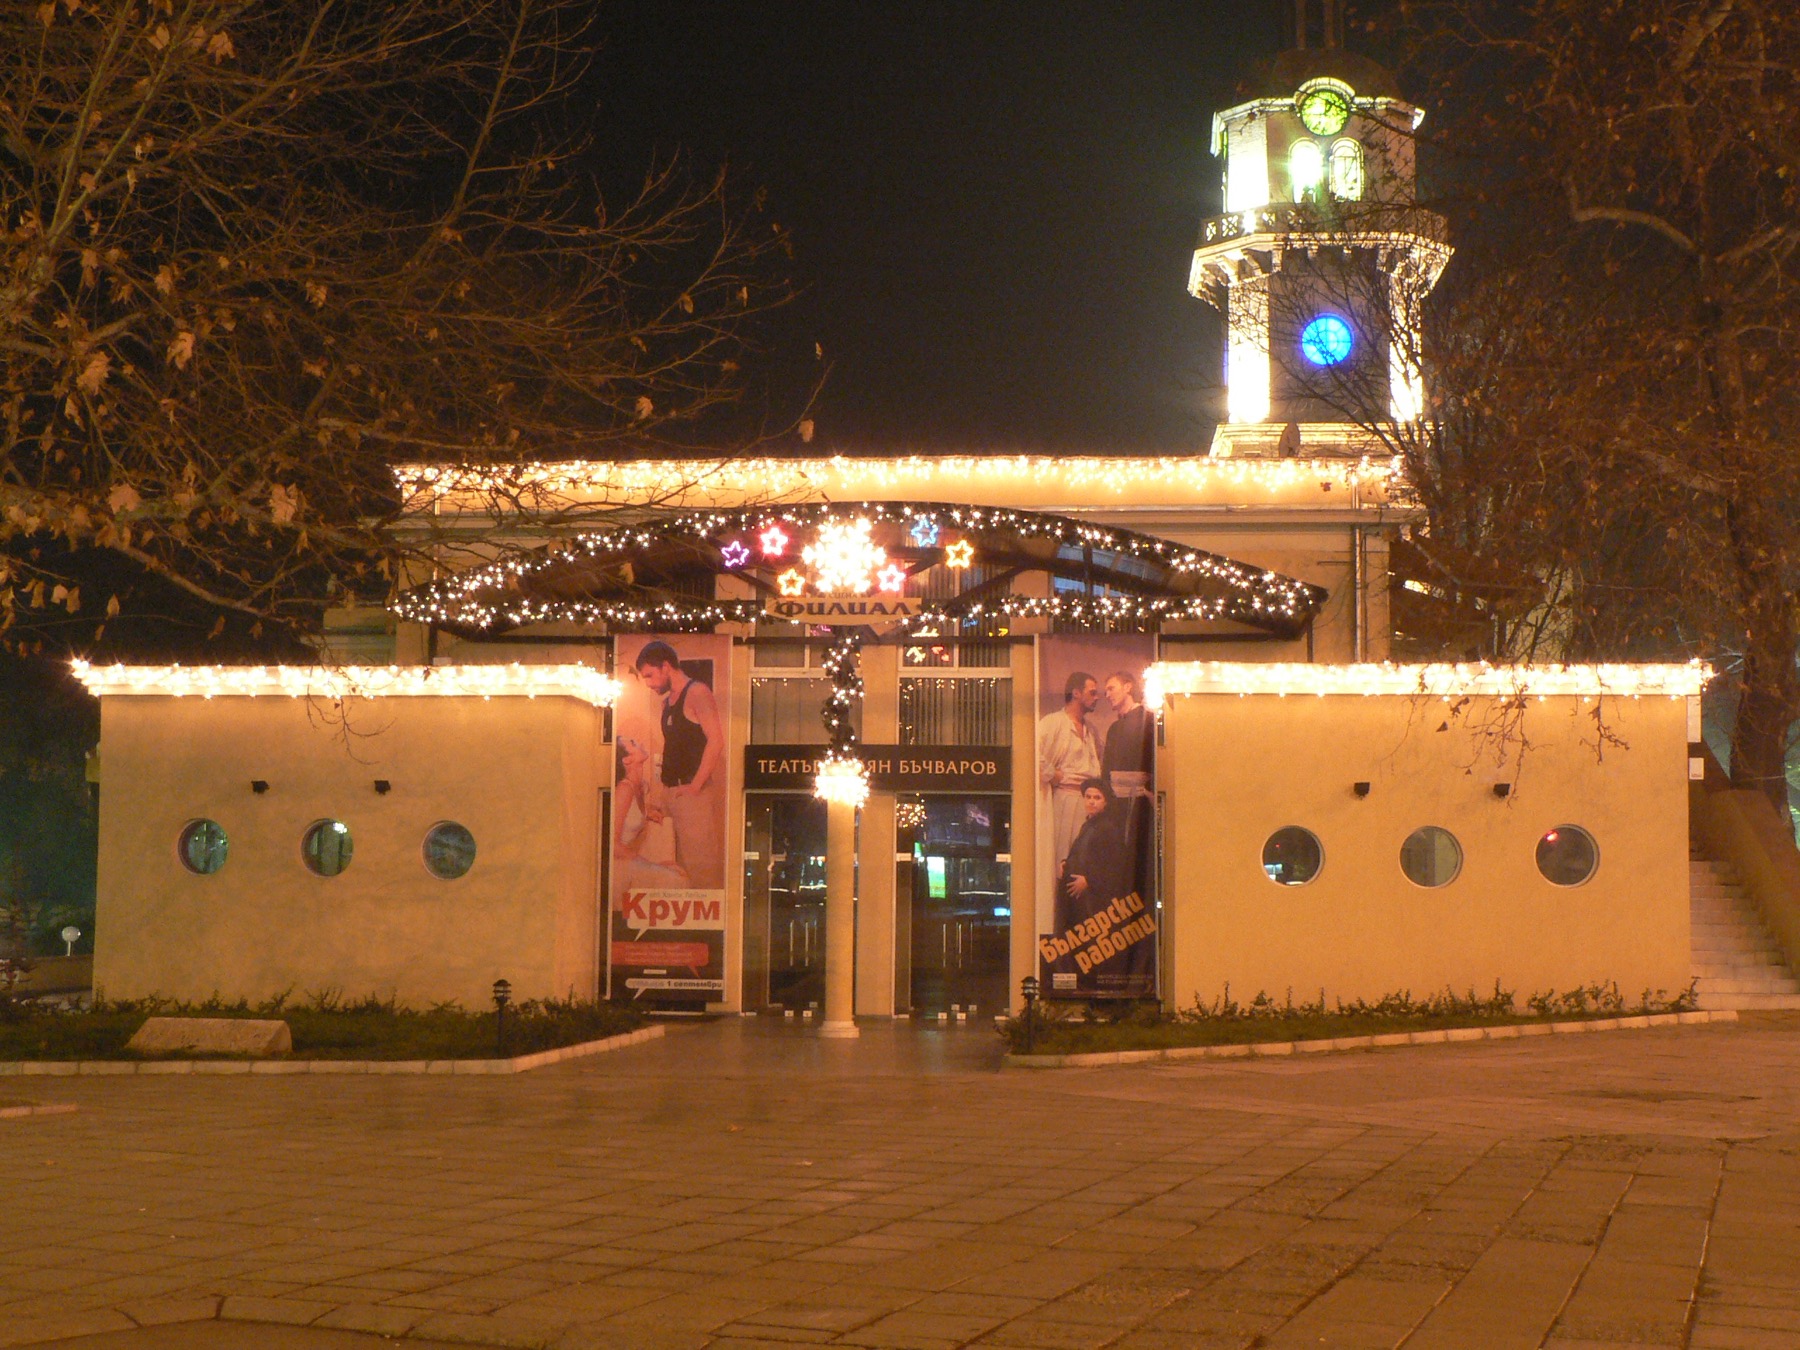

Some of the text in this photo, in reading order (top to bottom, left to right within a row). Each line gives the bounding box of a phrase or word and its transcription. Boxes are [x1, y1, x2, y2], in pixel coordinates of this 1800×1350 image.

[899, 760, 997, 775] БЪЧВАРОВ
[622, 892, 720, 927] Крум
[1074, 914, 1157, 975] работи
